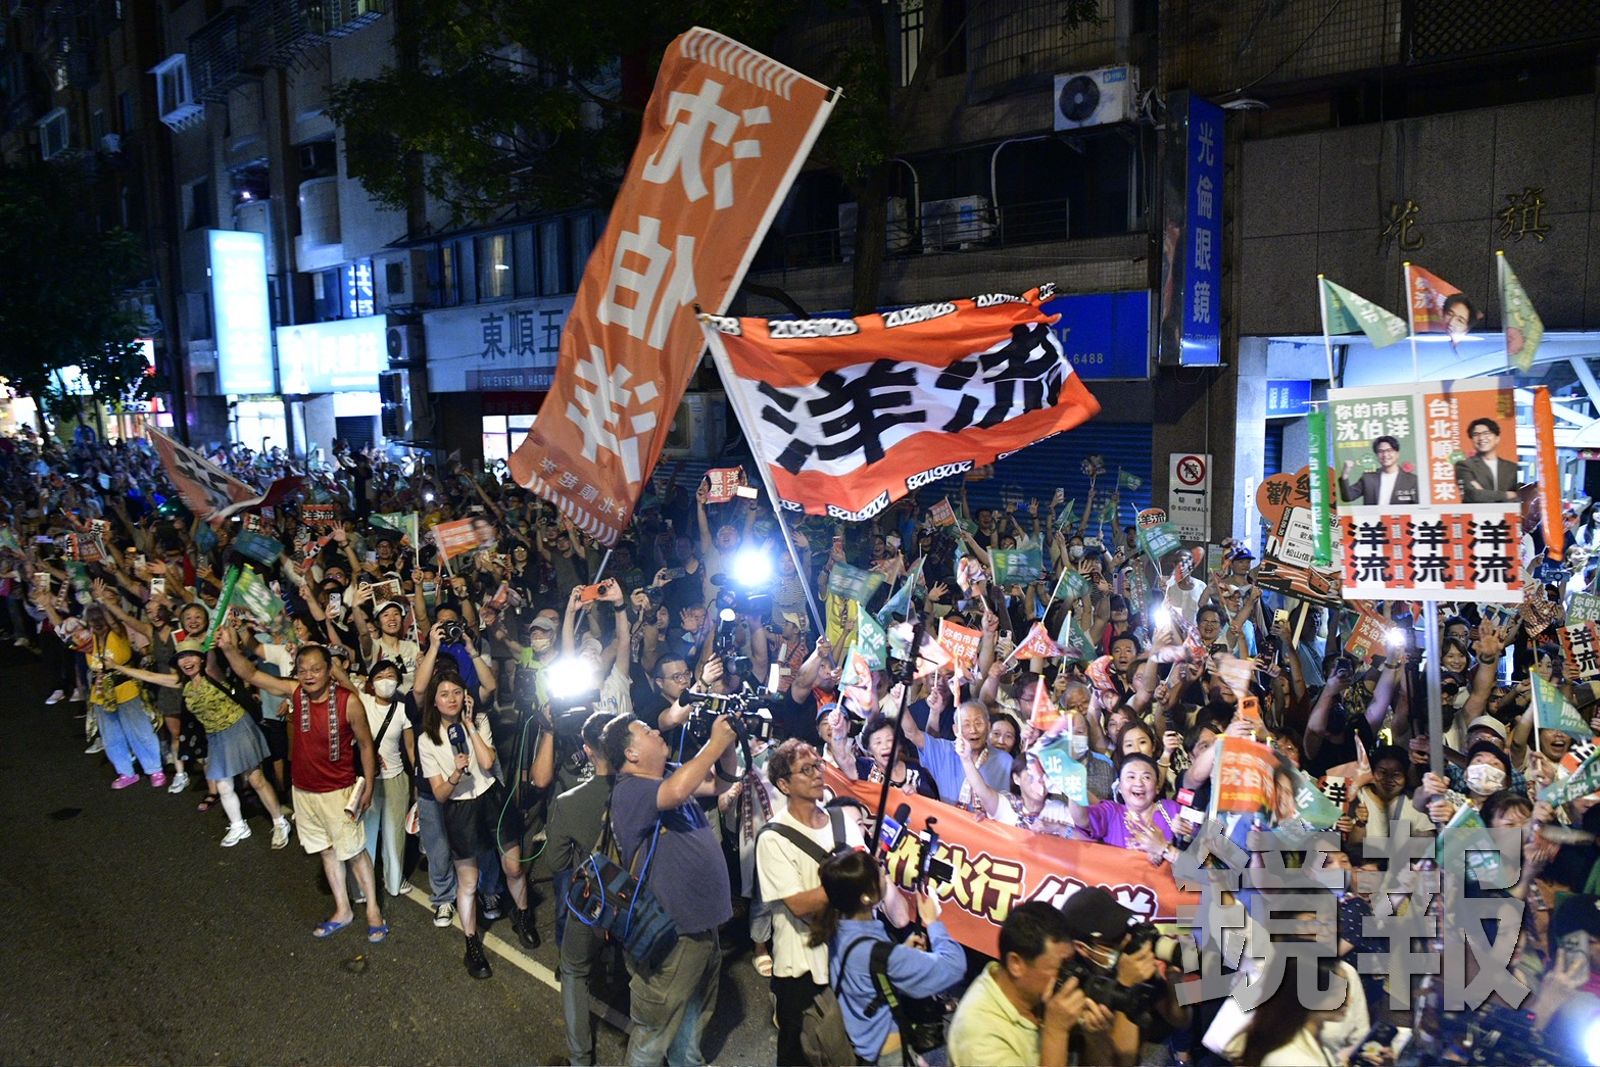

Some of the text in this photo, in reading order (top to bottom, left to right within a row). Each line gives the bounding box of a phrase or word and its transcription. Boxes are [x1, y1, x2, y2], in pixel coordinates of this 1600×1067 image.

[1193, 122, 1214, 324] 光倫眼鏡
[757, 322, 1063, 475] 洋流
[1335, 400, 1408, 420] 你的市長
[1336, 418, 1410, 441] 沈伯洋
[1428, 399, 1457, 501] 台北順起來
[1348, 521, 1393, 582] 洋流
[1406, 520, 1453, 582] 洋流
[1467, 520, 1516, 583] 洋流
